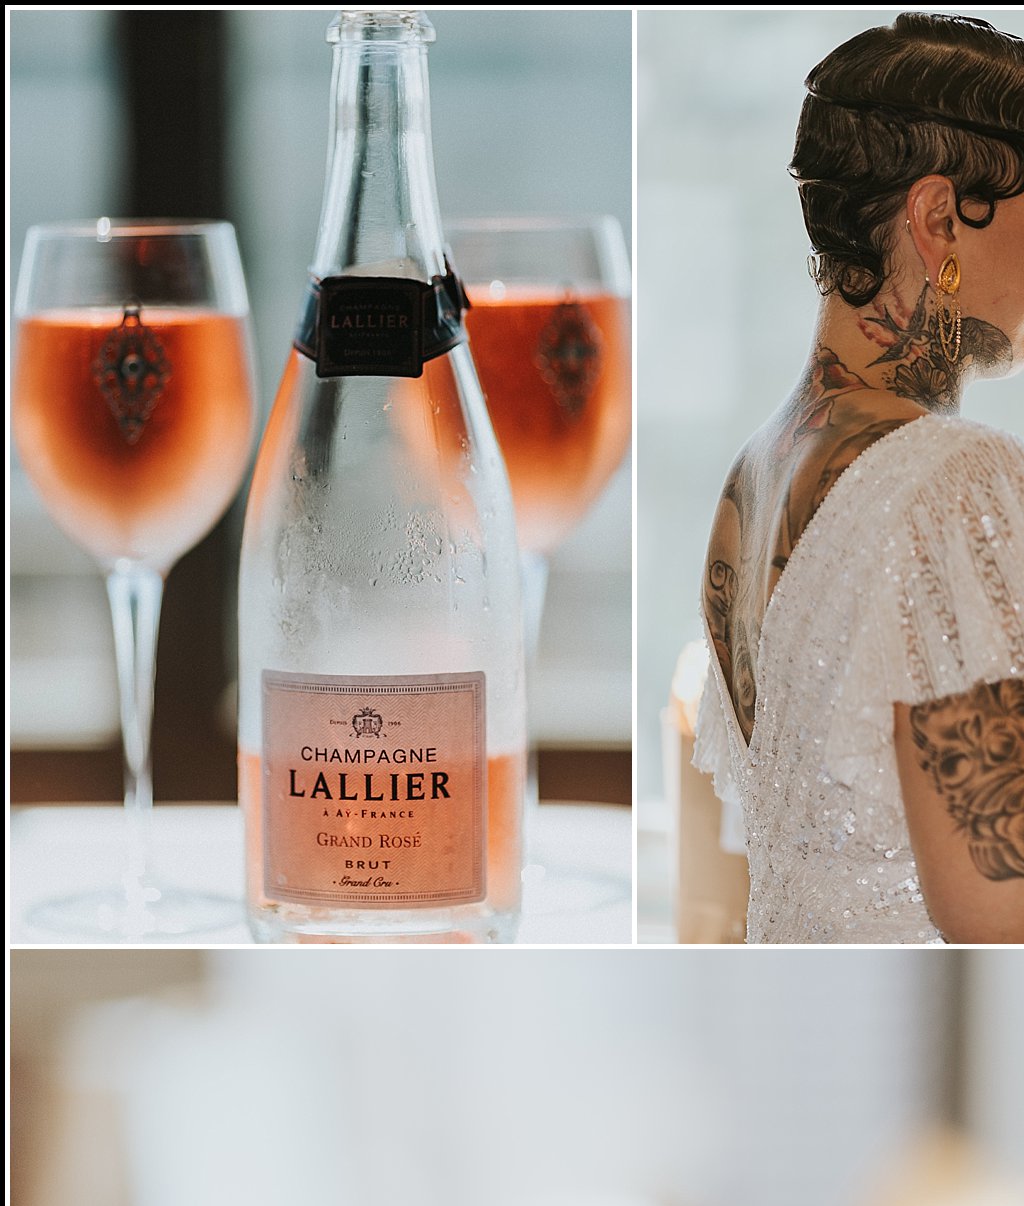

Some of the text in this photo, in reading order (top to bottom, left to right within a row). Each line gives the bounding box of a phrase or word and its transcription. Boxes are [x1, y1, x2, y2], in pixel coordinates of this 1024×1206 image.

[331, 315, 408, 328] LALLIER
[301, 746, 437, 763] CHAMPAGNE
[289, 769, 451, 801] LALLIER
[345, 860, 392, 870] BRUT
[338, 876, 393, 887] Grand Cru
